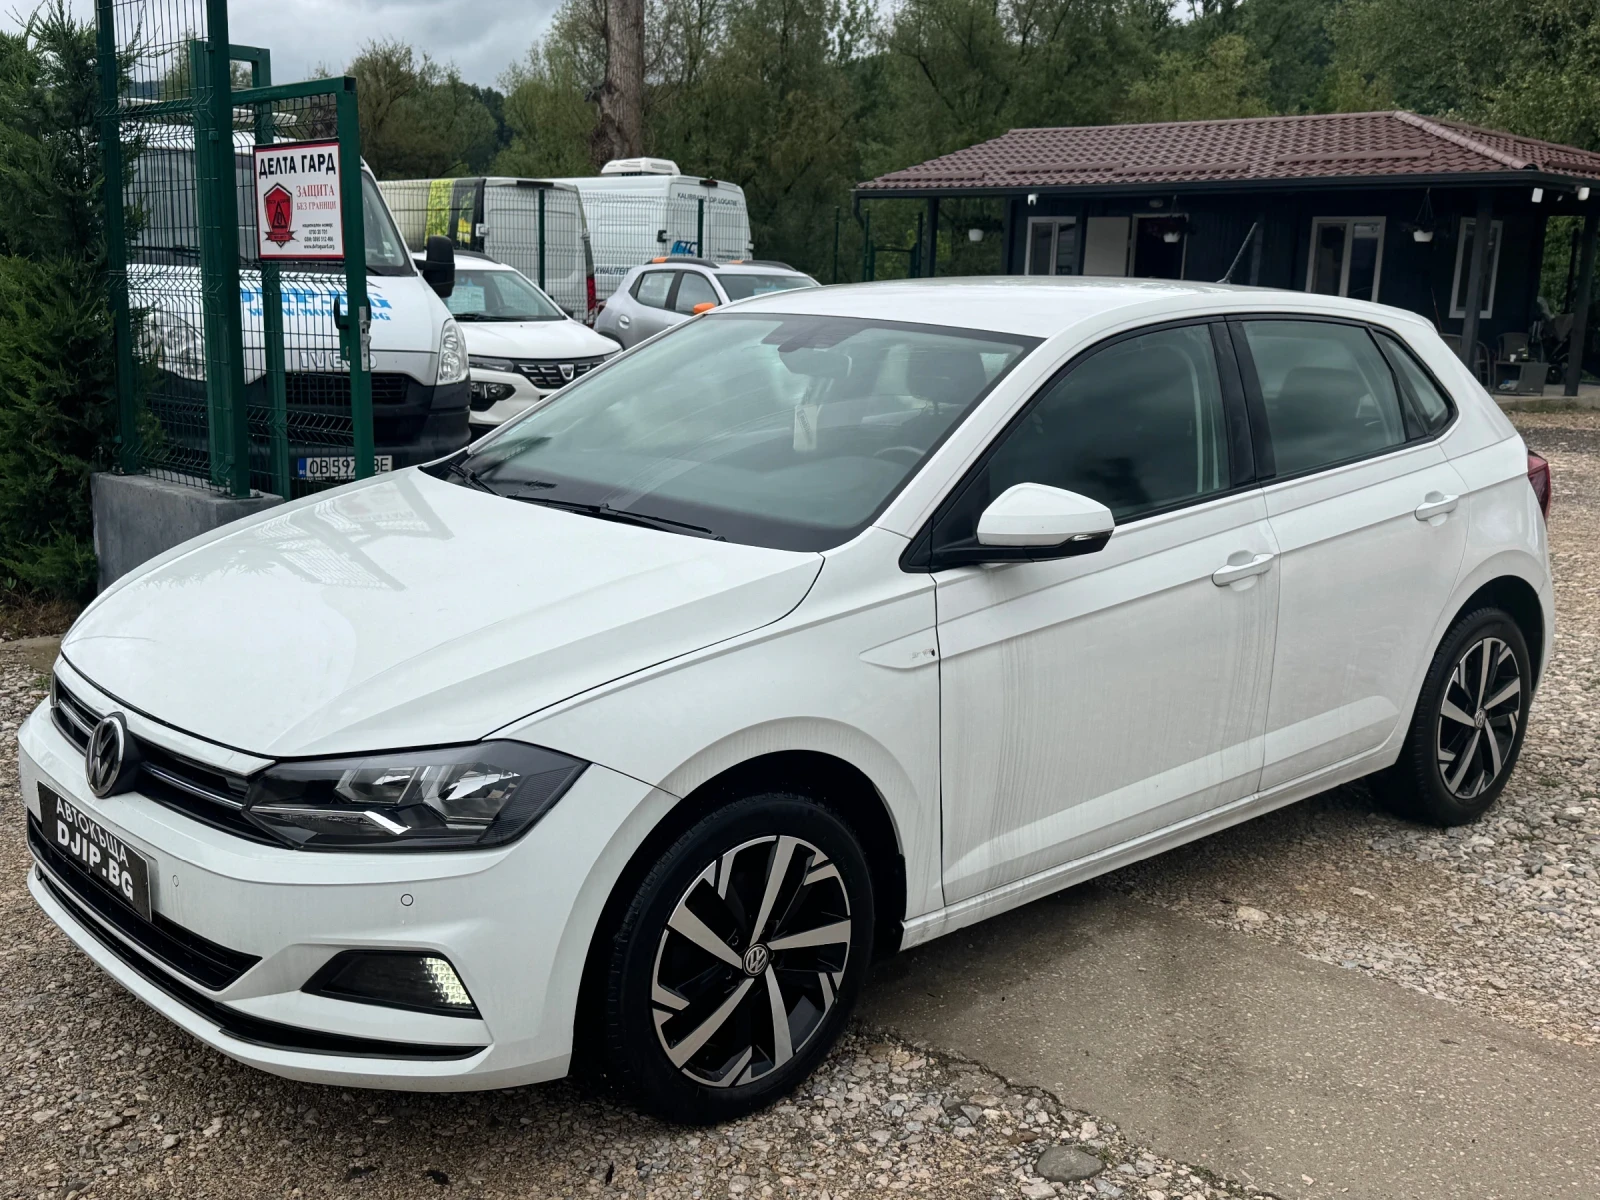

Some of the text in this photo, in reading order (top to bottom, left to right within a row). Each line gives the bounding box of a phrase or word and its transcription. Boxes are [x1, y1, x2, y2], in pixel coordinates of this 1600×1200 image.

[259, 153, 336, 179] ДЕЛТА ГАРД
[296, 184, 335, 199] ЗАЩИТА
[297, 202, 308, 210] БЕЗ
[308, 201, 337, 210] ГРАНИЦИ
[56, 796, 129, 868] АВТОКЪЩА
[57, 819, 134, 901] DJIP.BG
